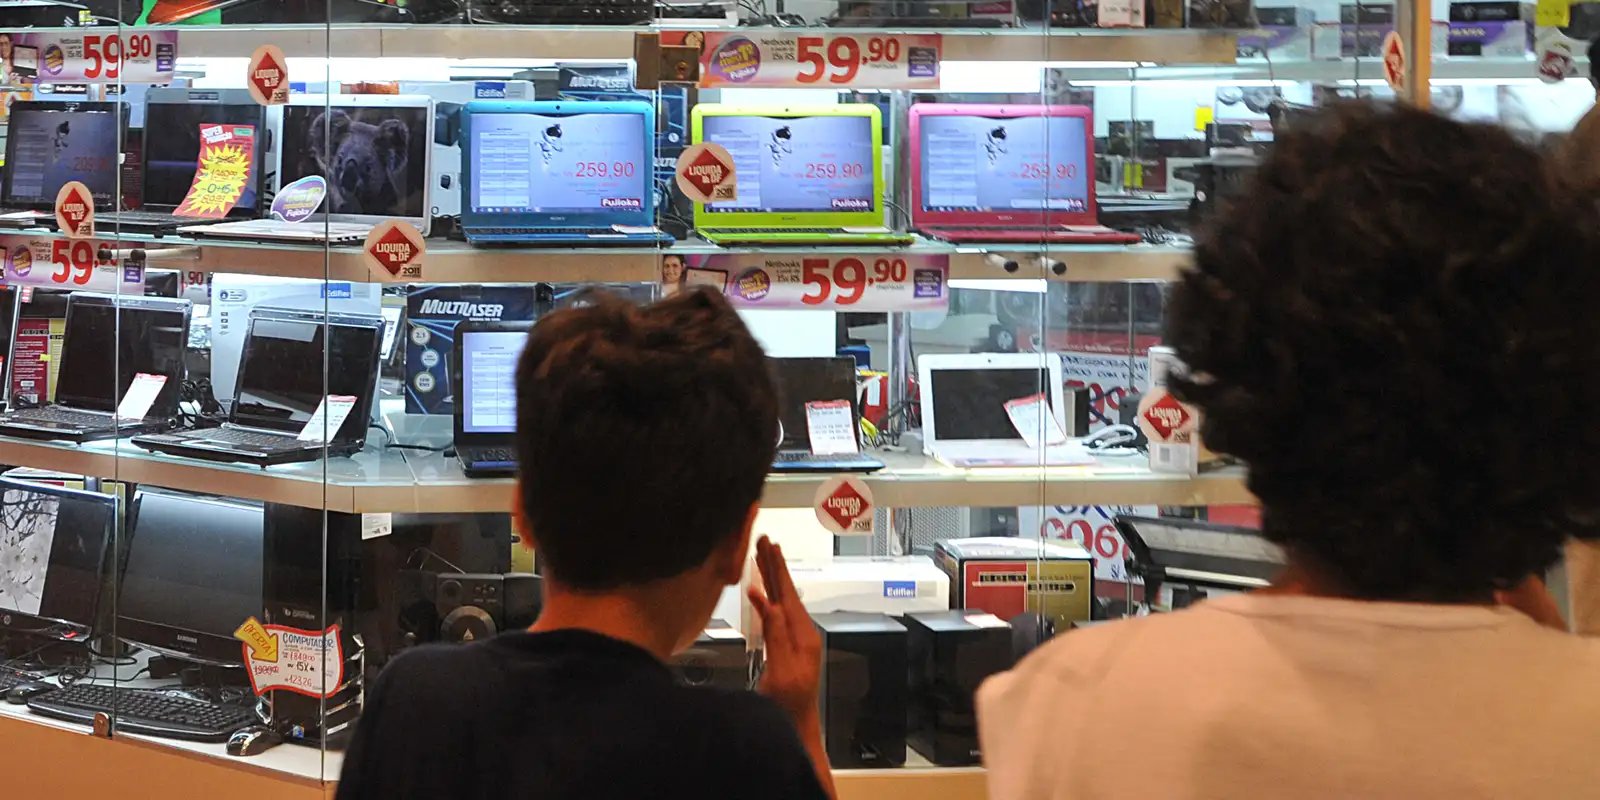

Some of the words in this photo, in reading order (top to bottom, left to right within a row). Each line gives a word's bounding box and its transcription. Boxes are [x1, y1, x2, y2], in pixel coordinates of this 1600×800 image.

[83, 34, 152, 79] 59,90
[796, 36, 900, 84] 59,90
[688, 164, 722, 176] LIQUIDA
[602, 199, 640, 207] Fujioka
[376, 243, 411, 253] LIQUIDA
[398, 252, 410, 261] DF
[402, 267, 420, 275] 2011
[801, 258, 907, 305] 59,90
[419, 299, 504, 317] MULTILASER
[828, 497, 861, 508] LIQUIDA
[886, 586, 915, 597] Edifier
[283, 632, 335, 648] COMPUTADR
